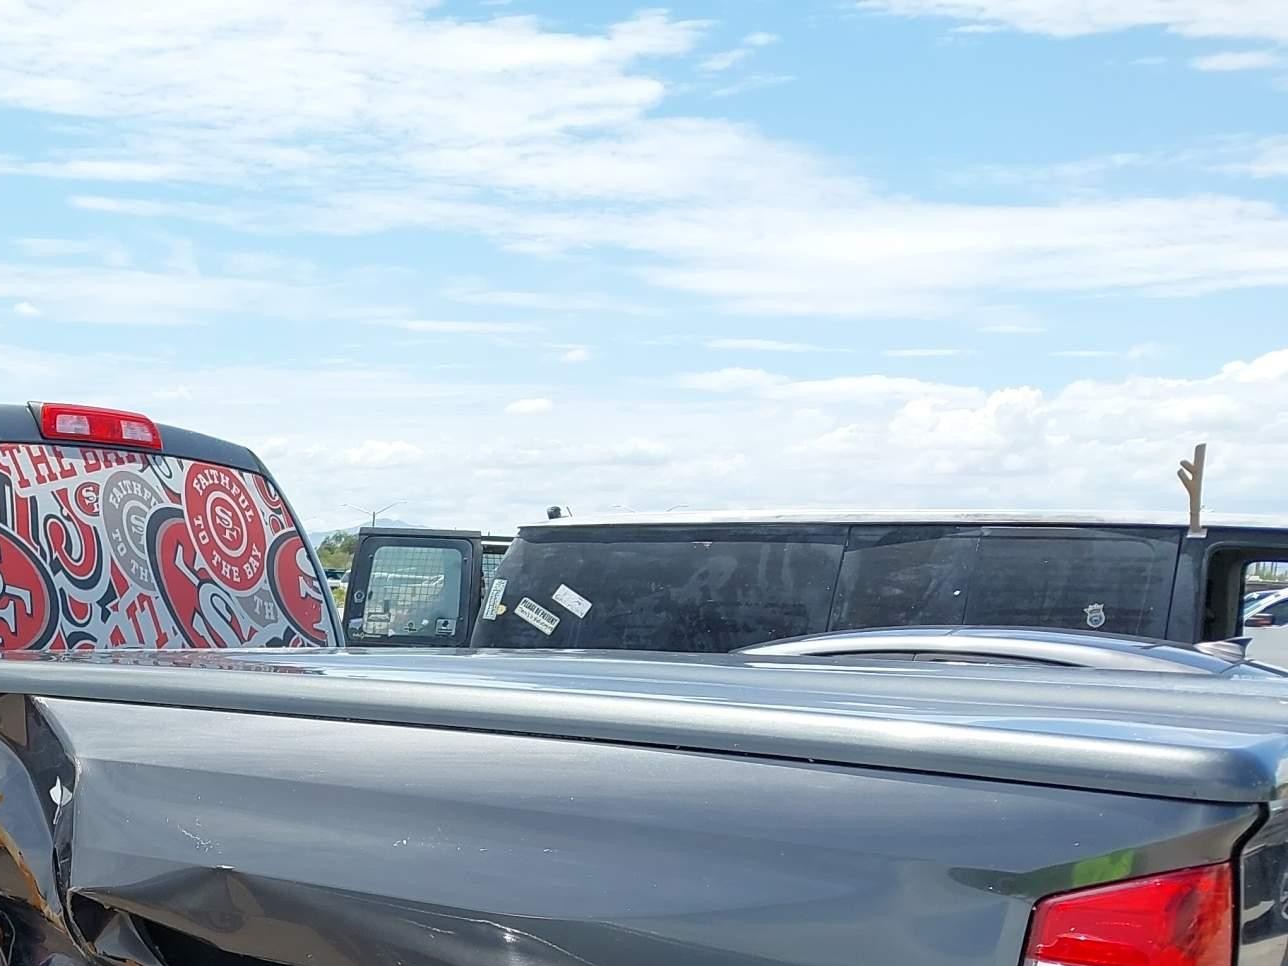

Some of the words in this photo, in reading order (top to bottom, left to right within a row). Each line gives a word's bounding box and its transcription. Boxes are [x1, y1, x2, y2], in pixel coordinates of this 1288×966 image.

[193, 469, 255, 522] FAITHFUL
[194, 516, 209, 545] TO
[212, 550, 241, 582] THE
[242, 543, 262, 579] BAY
[215, 505, 241, 541] SF
